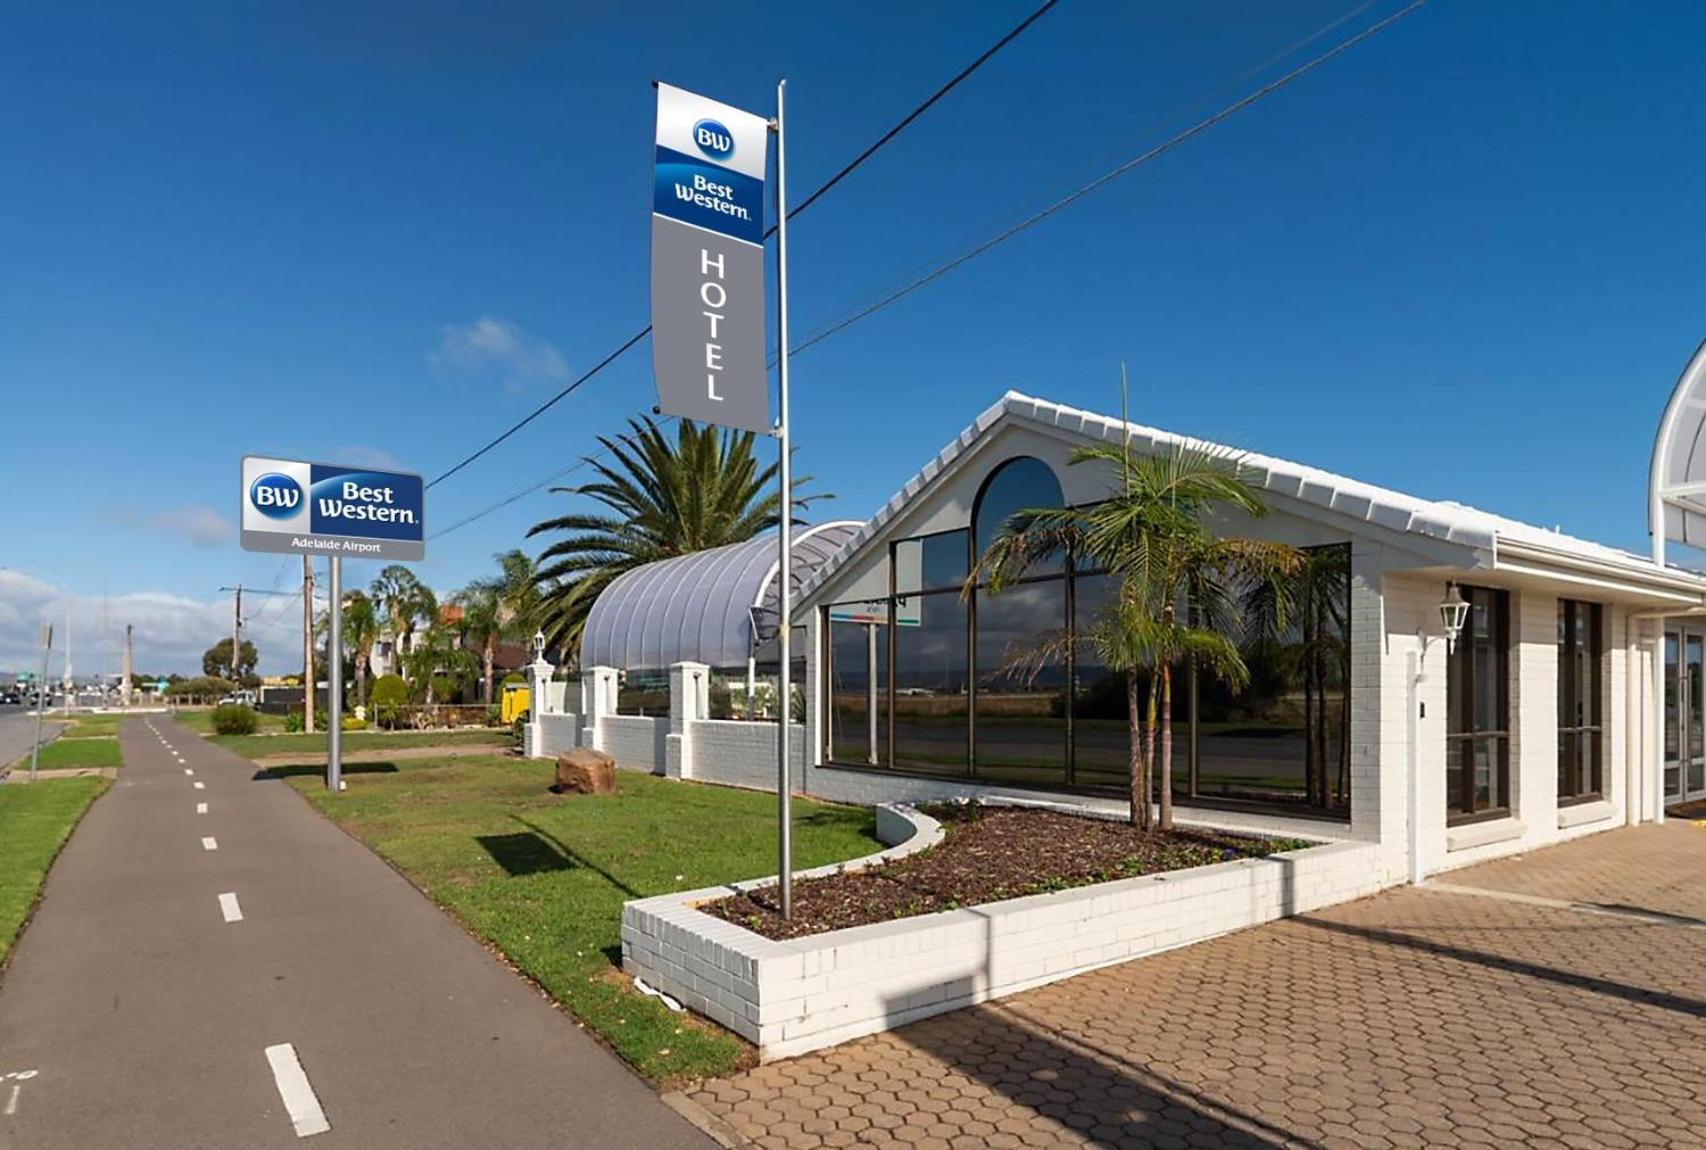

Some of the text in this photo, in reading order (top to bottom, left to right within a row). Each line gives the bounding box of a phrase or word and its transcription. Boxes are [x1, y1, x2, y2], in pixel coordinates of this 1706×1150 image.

[698, 127, 730, 152] BW
[694, 174, 733, 200] Best
[701, 249, 727, 401] HOTEL
[256, 485, 299, 508] BW
[342, 481, 394, 504] Best
[291, 537, 382, 553] Adelaide Airport
